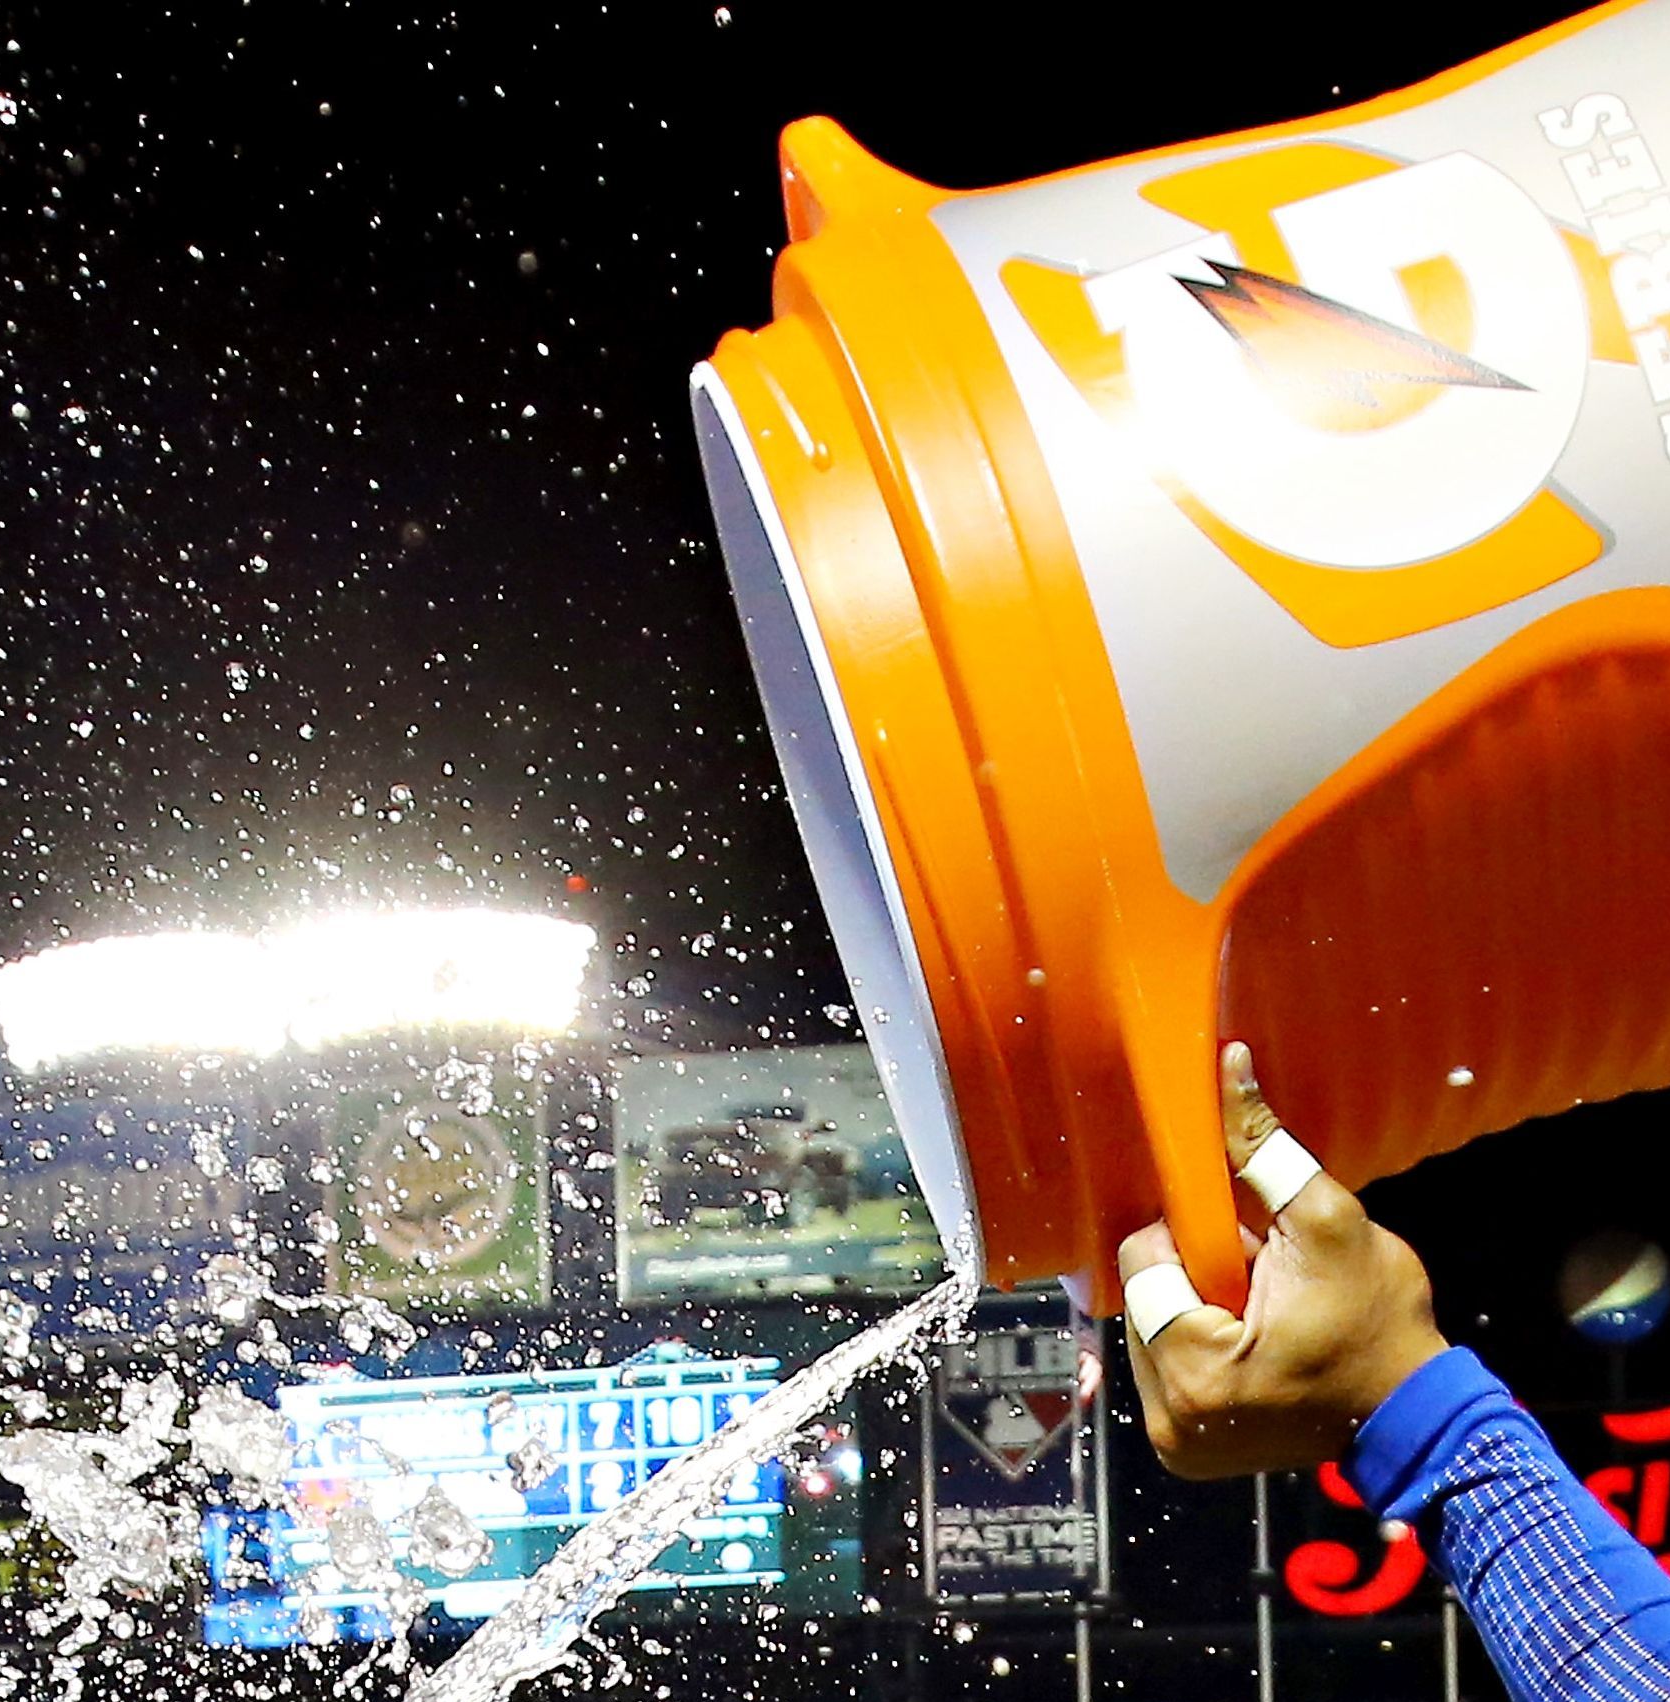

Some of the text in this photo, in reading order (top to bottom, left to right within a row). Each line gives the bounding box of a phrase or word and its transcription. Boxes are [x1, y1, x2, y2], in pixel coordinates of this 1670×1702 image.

[588, 1400, 621, 1449] 7
[645, 1396, 702, 1447] 10
[936, 1523, 1097, 1550] PASTIME
